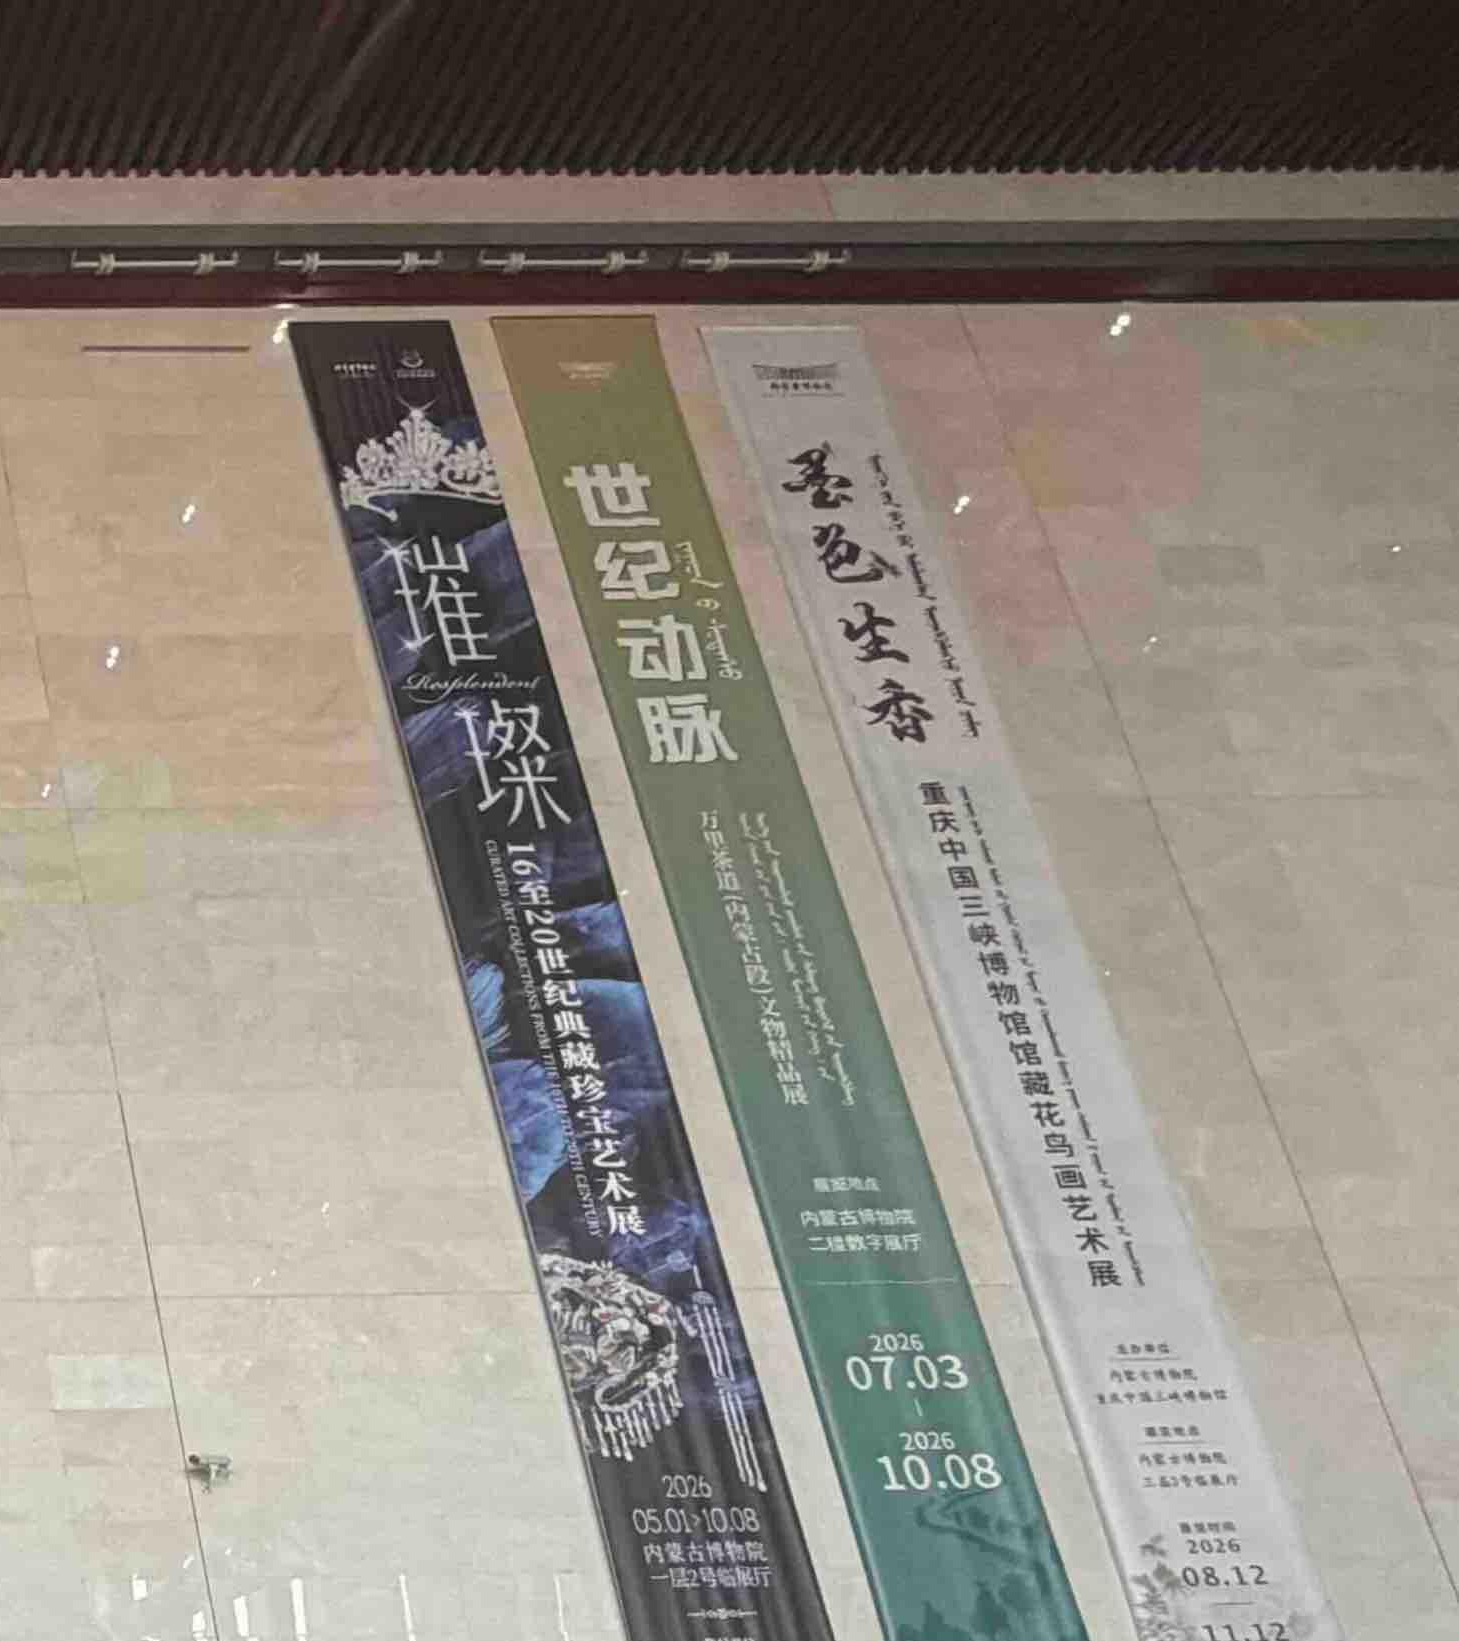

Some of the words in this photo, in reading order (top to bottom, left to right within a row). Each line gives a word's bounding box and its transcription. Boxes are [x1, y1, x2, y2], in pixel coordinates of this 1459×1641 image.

[563, 462, 740, 763] 世纪动脉
[401, 671, 542, 704] Resplendent
[918, 781, 1122, 1287] 重庆中国三峡博物馆馆藏花鸟画艺术展
[868, 1333, 924, 1352] 2026
[845, 1354, 970, 1391] 07.03
[899, 1431, 956, 1450] 2026
[876, 1453, 1003, 1491] 10.08
[661, 1475, 713, 1498] 2026
[643, 1541, 768, 1564] 内蒙古博物院
[1187, 1538, 1242, 1555] 2026
[1182, 1565, 1269, 1588] 08.12
